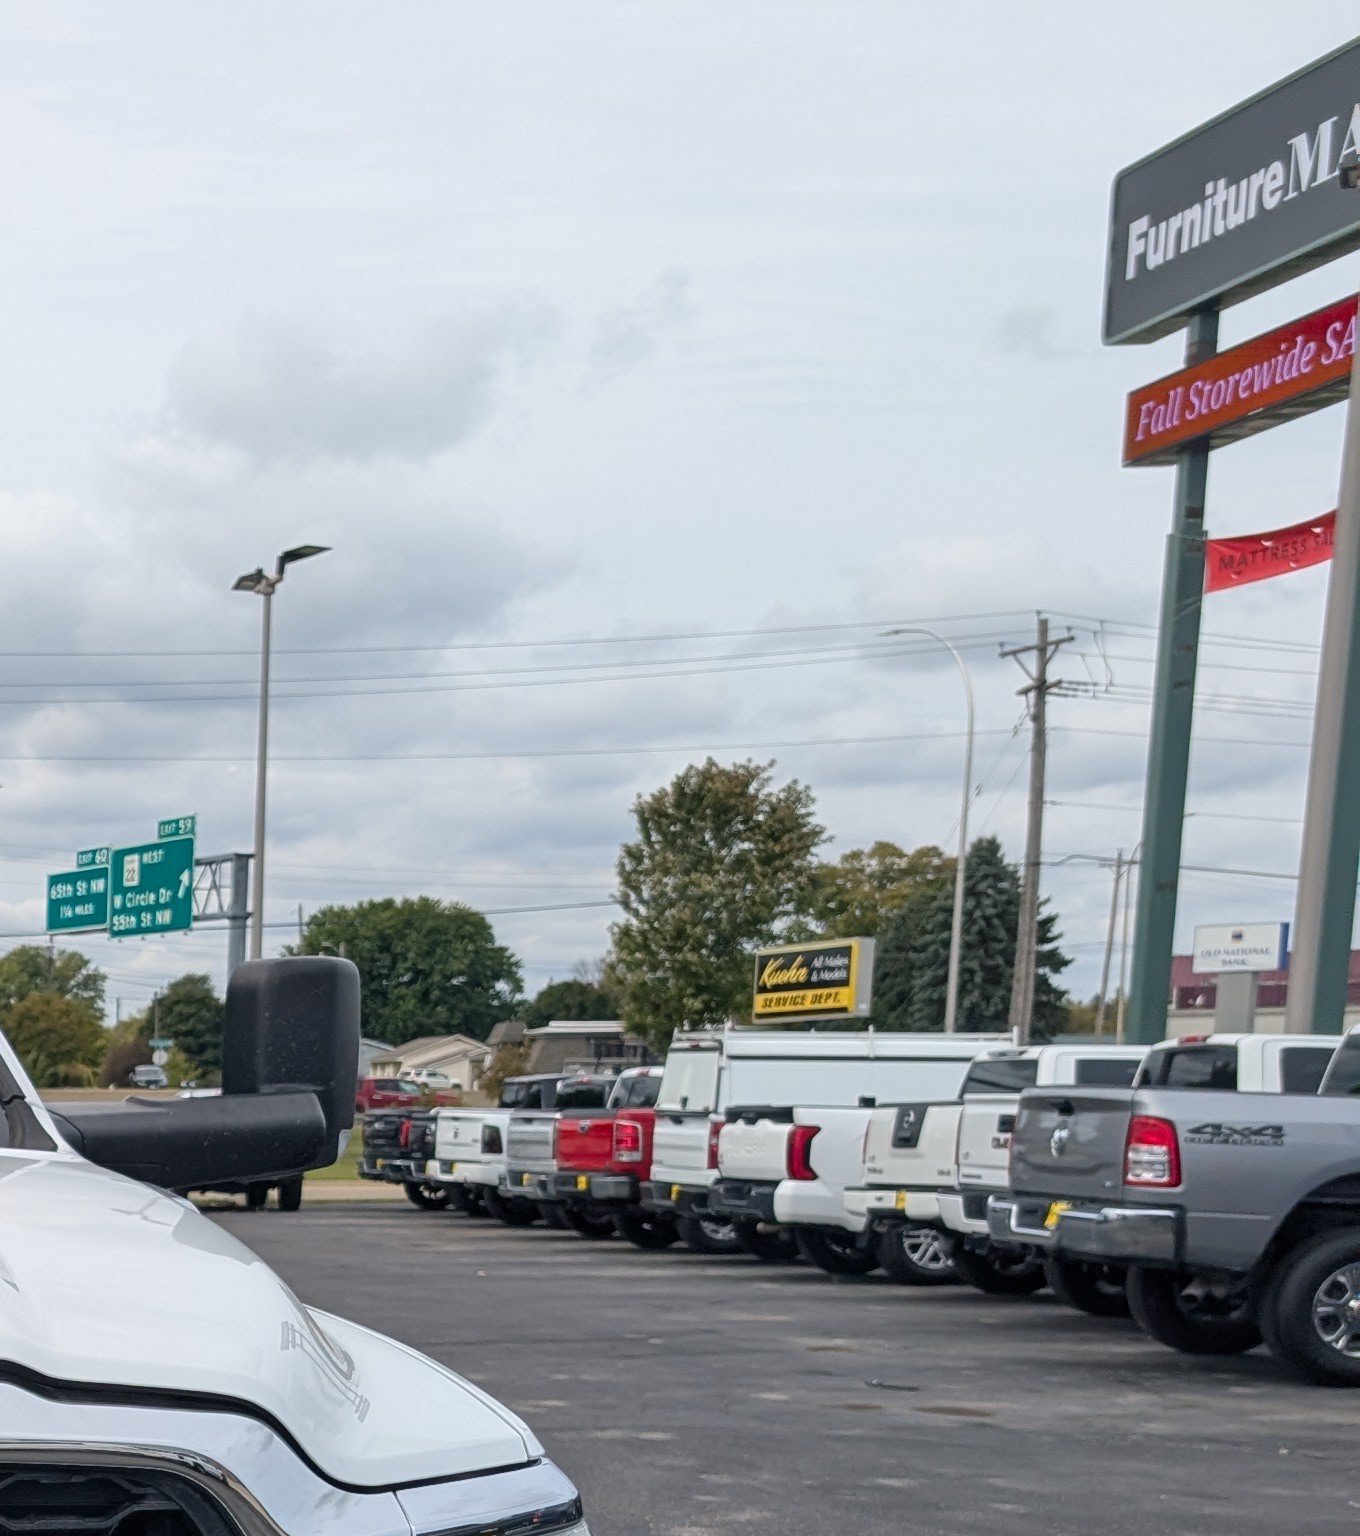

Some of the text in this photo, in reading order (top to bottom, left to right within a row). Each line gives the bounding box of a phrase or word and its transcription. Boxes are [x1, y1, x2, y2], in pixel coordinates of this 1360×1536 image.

[1135, 386, 1185, 441] Fall
[1185, 335, 1318, 421] Storewide
[1218, 538, 1307, 571] MATTRESS
[125, 868, 137, 883] 22
[76, 880, 88, 896] St
[125, 891, 156, 908] Circle
[158, 887, 173, 904] Dr
[113, 914, 137, 931] 55th
[141, 911, 153, 928] St
[758, 954, 809, 989] Kuehn
[762, 993, 806, 1008] SERVICE
[1186, 1123, 1285, 1139] 4x4
